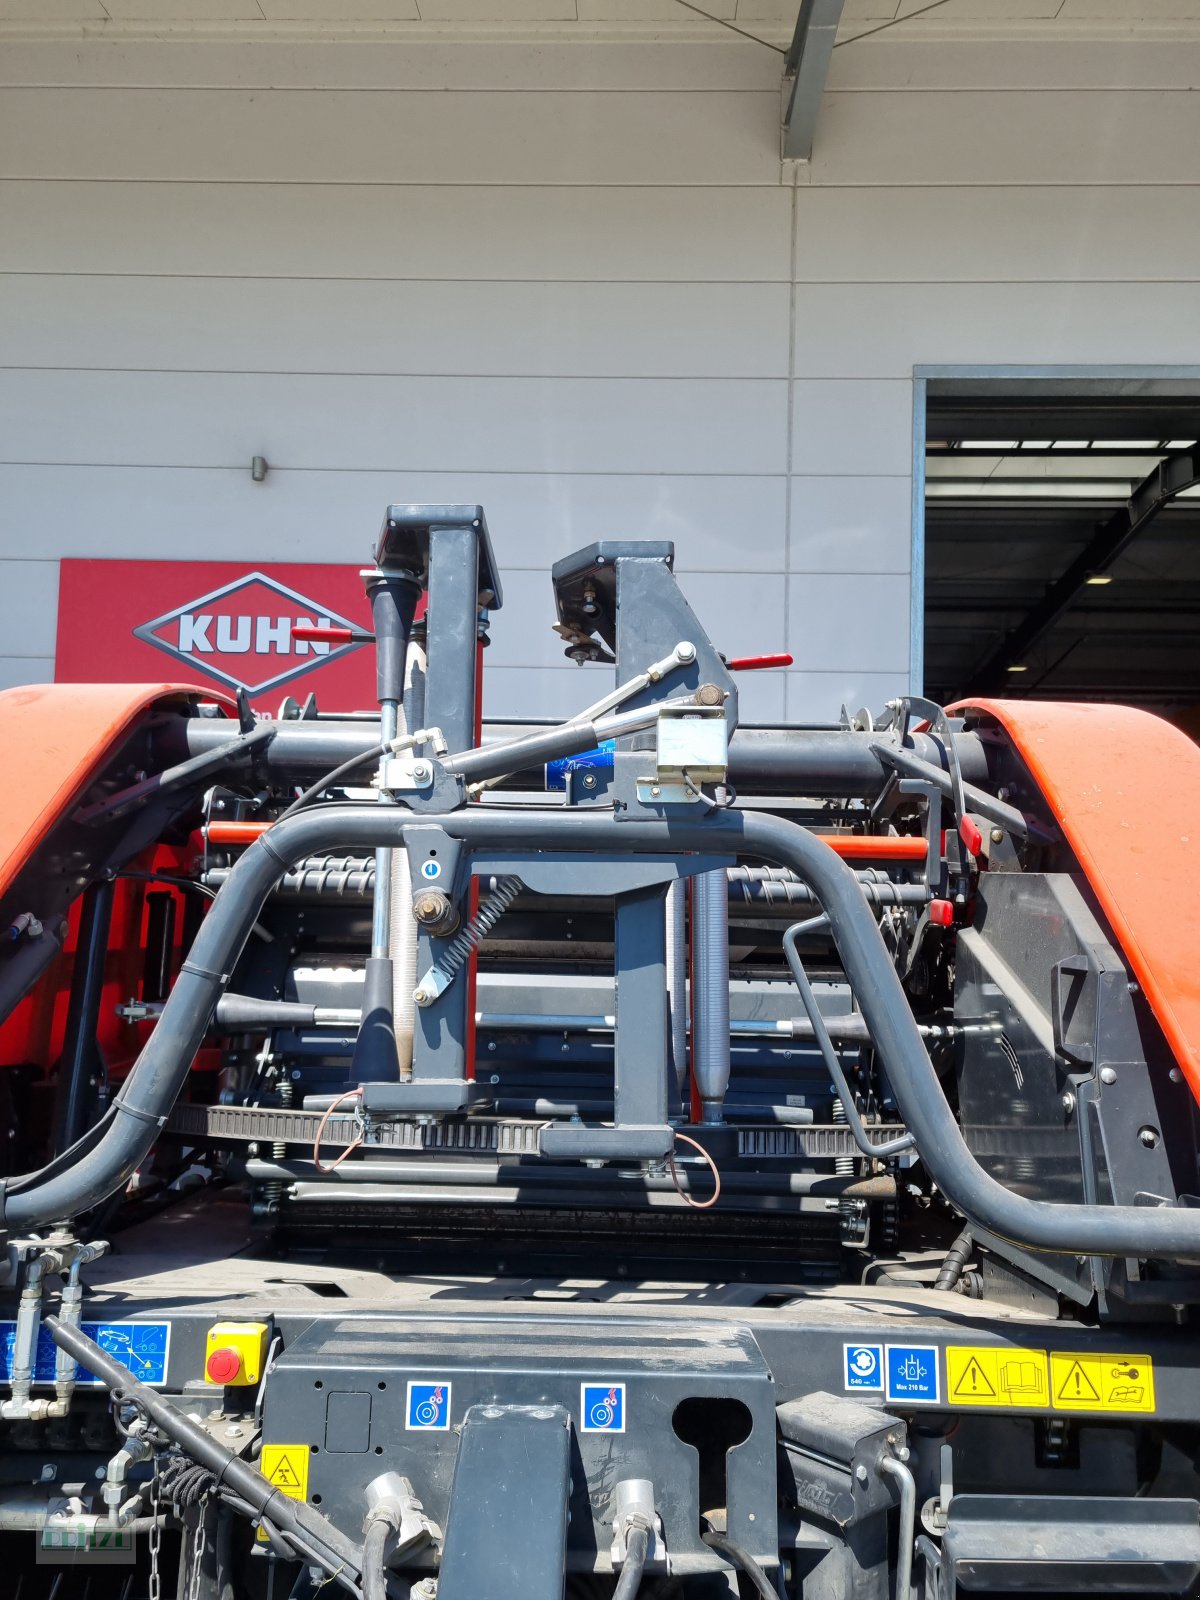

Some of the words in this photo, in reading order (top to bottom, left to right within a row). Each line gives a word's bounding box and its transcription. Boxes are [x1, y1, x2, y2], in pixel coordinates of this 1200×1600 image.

[178, 614, 331, 656] KUHN
[896, 1383, 908, 1391] Max
[919, 1384, 929, 1392] Bar
